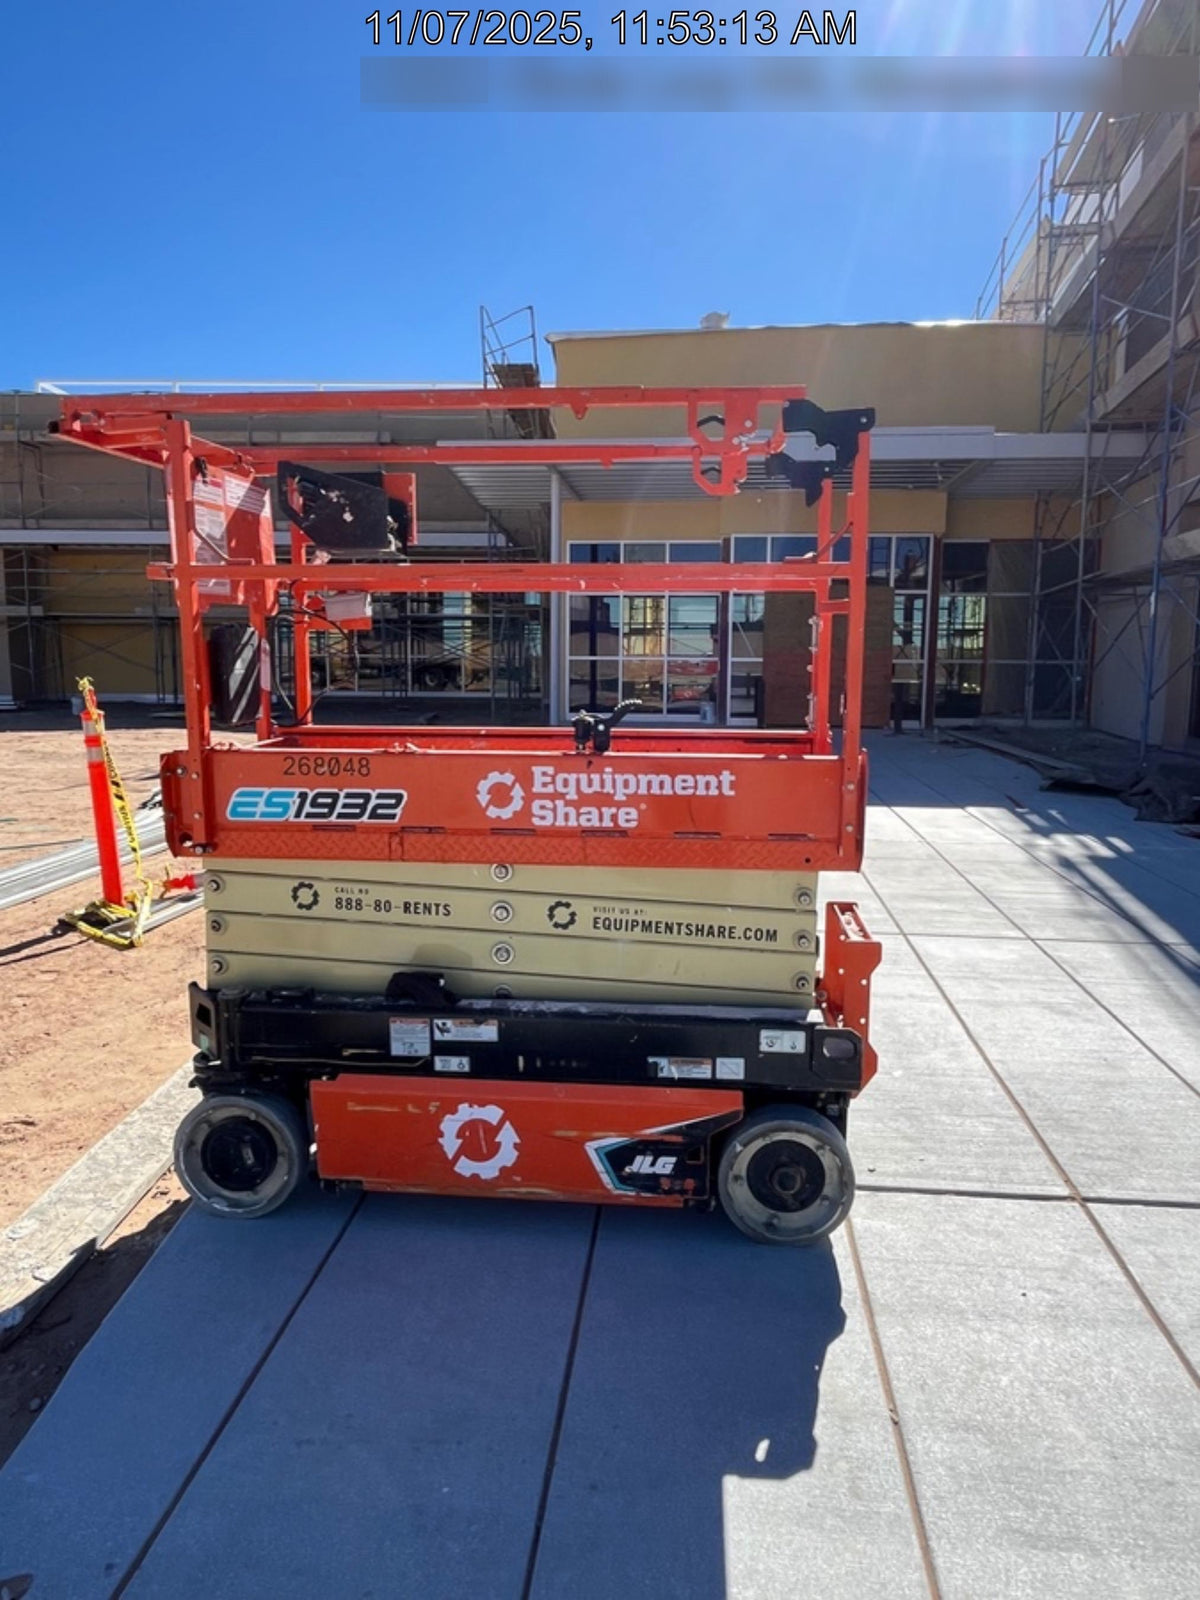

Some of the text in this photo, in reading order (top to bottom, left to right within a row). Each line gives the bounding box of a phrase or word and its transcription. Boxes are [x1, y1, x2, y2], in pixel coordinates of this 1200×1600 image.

[282, 755, 371, 778] 268048
[530, 765, 736, 801] Equipment
[226, 786, 408, 823] ES1932
[334, 896, 452, 917] 888-80-RENTS
[592, 916, 778, 943] EQUIPMENTSHARE.COM
[625, 1154, 678, 1175] JLG
